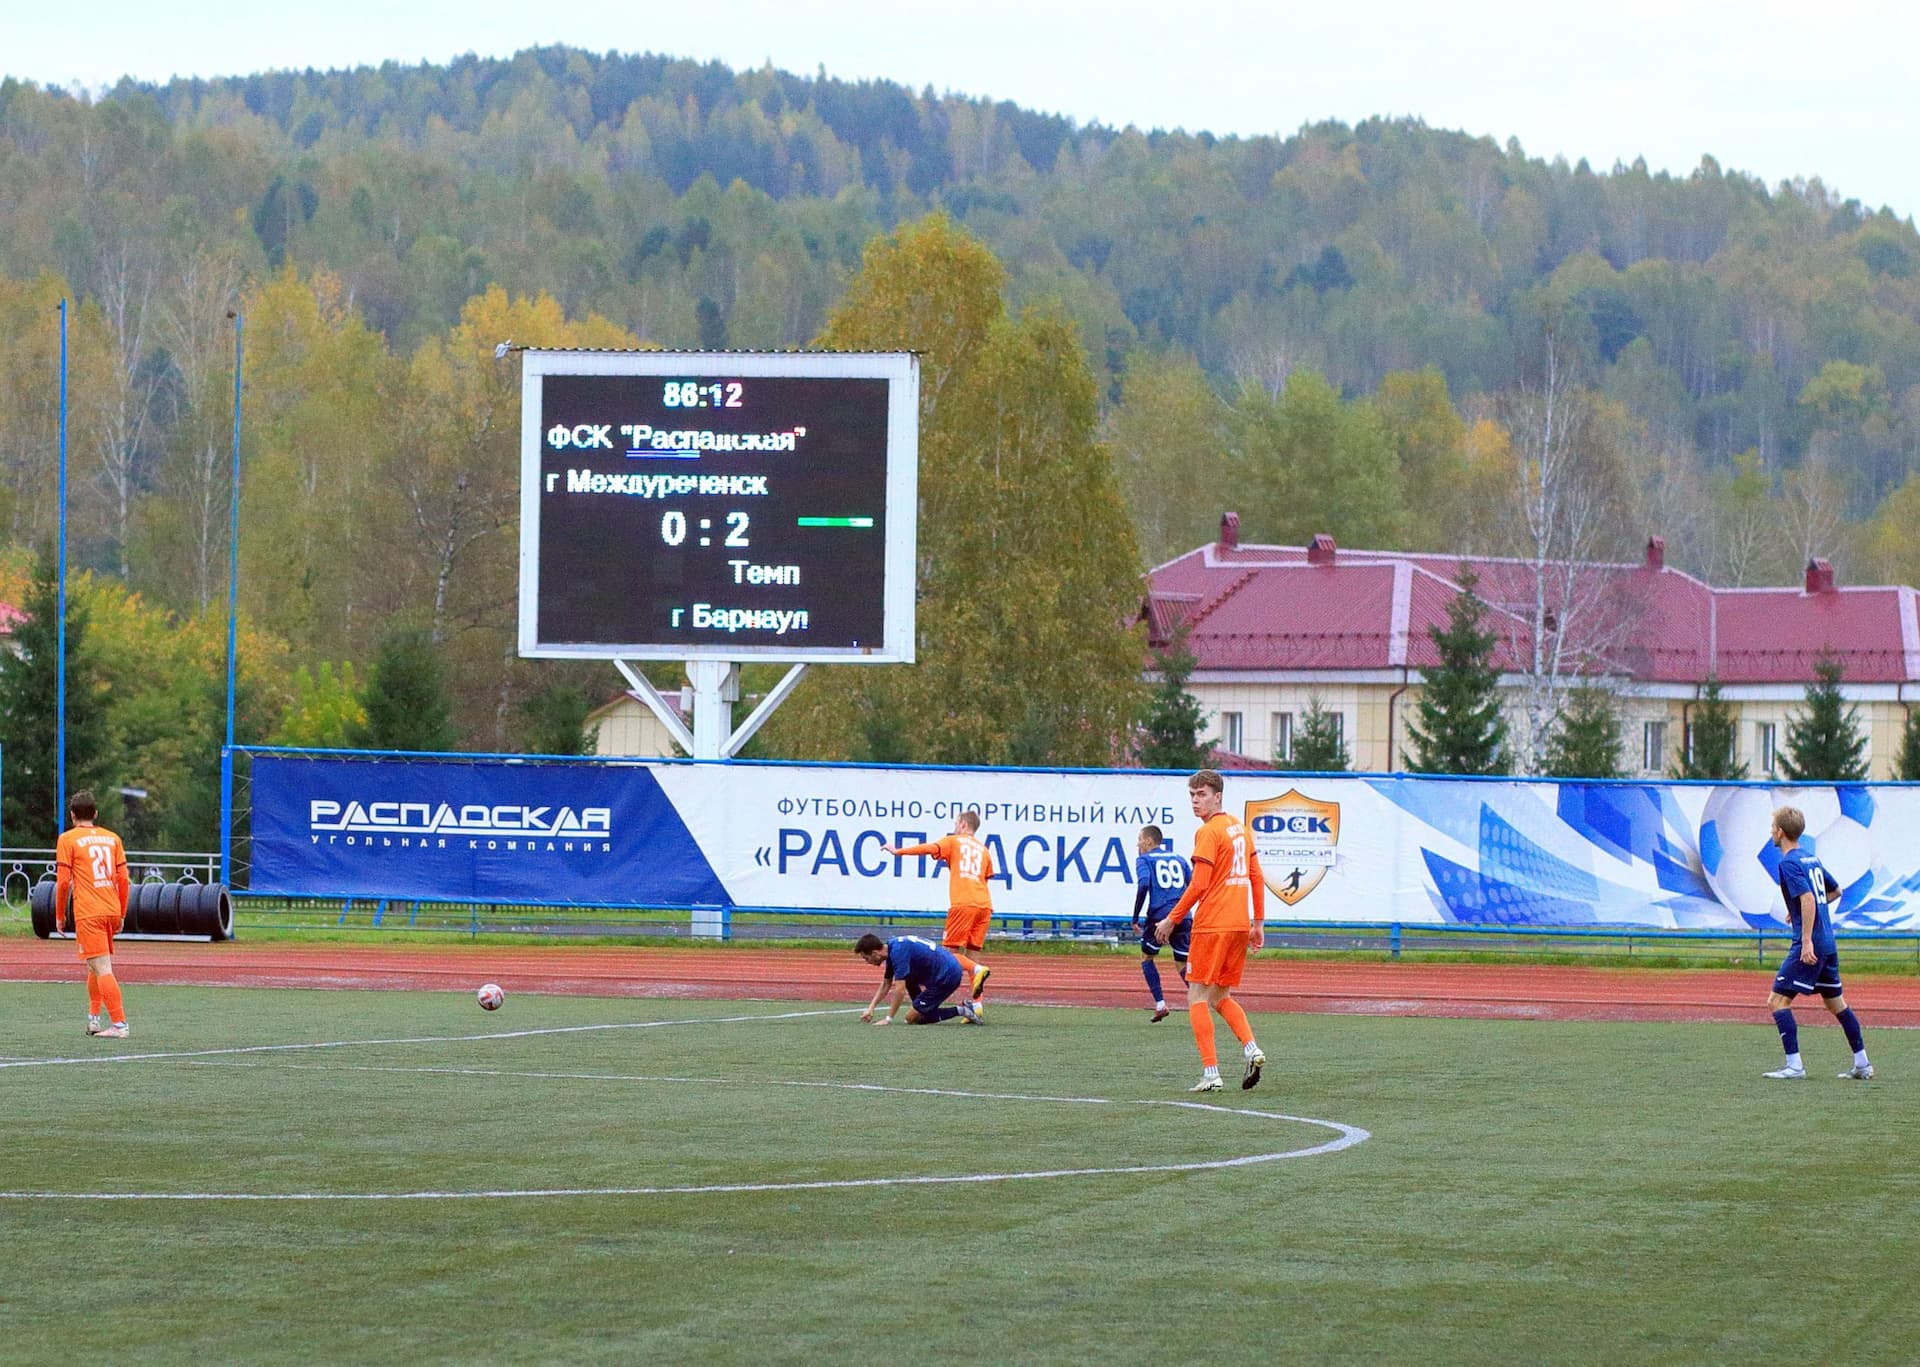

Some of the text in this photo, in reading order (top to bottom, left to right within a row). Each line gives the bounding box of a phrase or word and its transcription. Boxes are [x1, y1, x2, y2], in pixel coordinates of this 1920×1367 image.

[663, 382, 743, 407] 86:12
[547, 424, 613, 449] ФСК
[546, 469, 768, 498] г Междуреченск
[728, 560, 800, 585] Темп
[672, 603, 809, 634] г Барнаул
[311, 800, 610, 837] РАСПАДСКАЯ
[777, 797, 1175, 824] ФУТБОЛЬНО-СПОРТИВНЫЙ КЛУБ
[1252, 815, 1332, 833] ФСК
[311, 835, 610, 852] УГОЛЬНАЯ КОМПАНИЯ
[88, 845, 112, 880] 21
[754, 828, 1174, 890] «РАСПДСКА
[959, 842, 983, 876] 33
[1155, 860, 1185, 889] 69
[1808, 866, 1827, 904] 19
